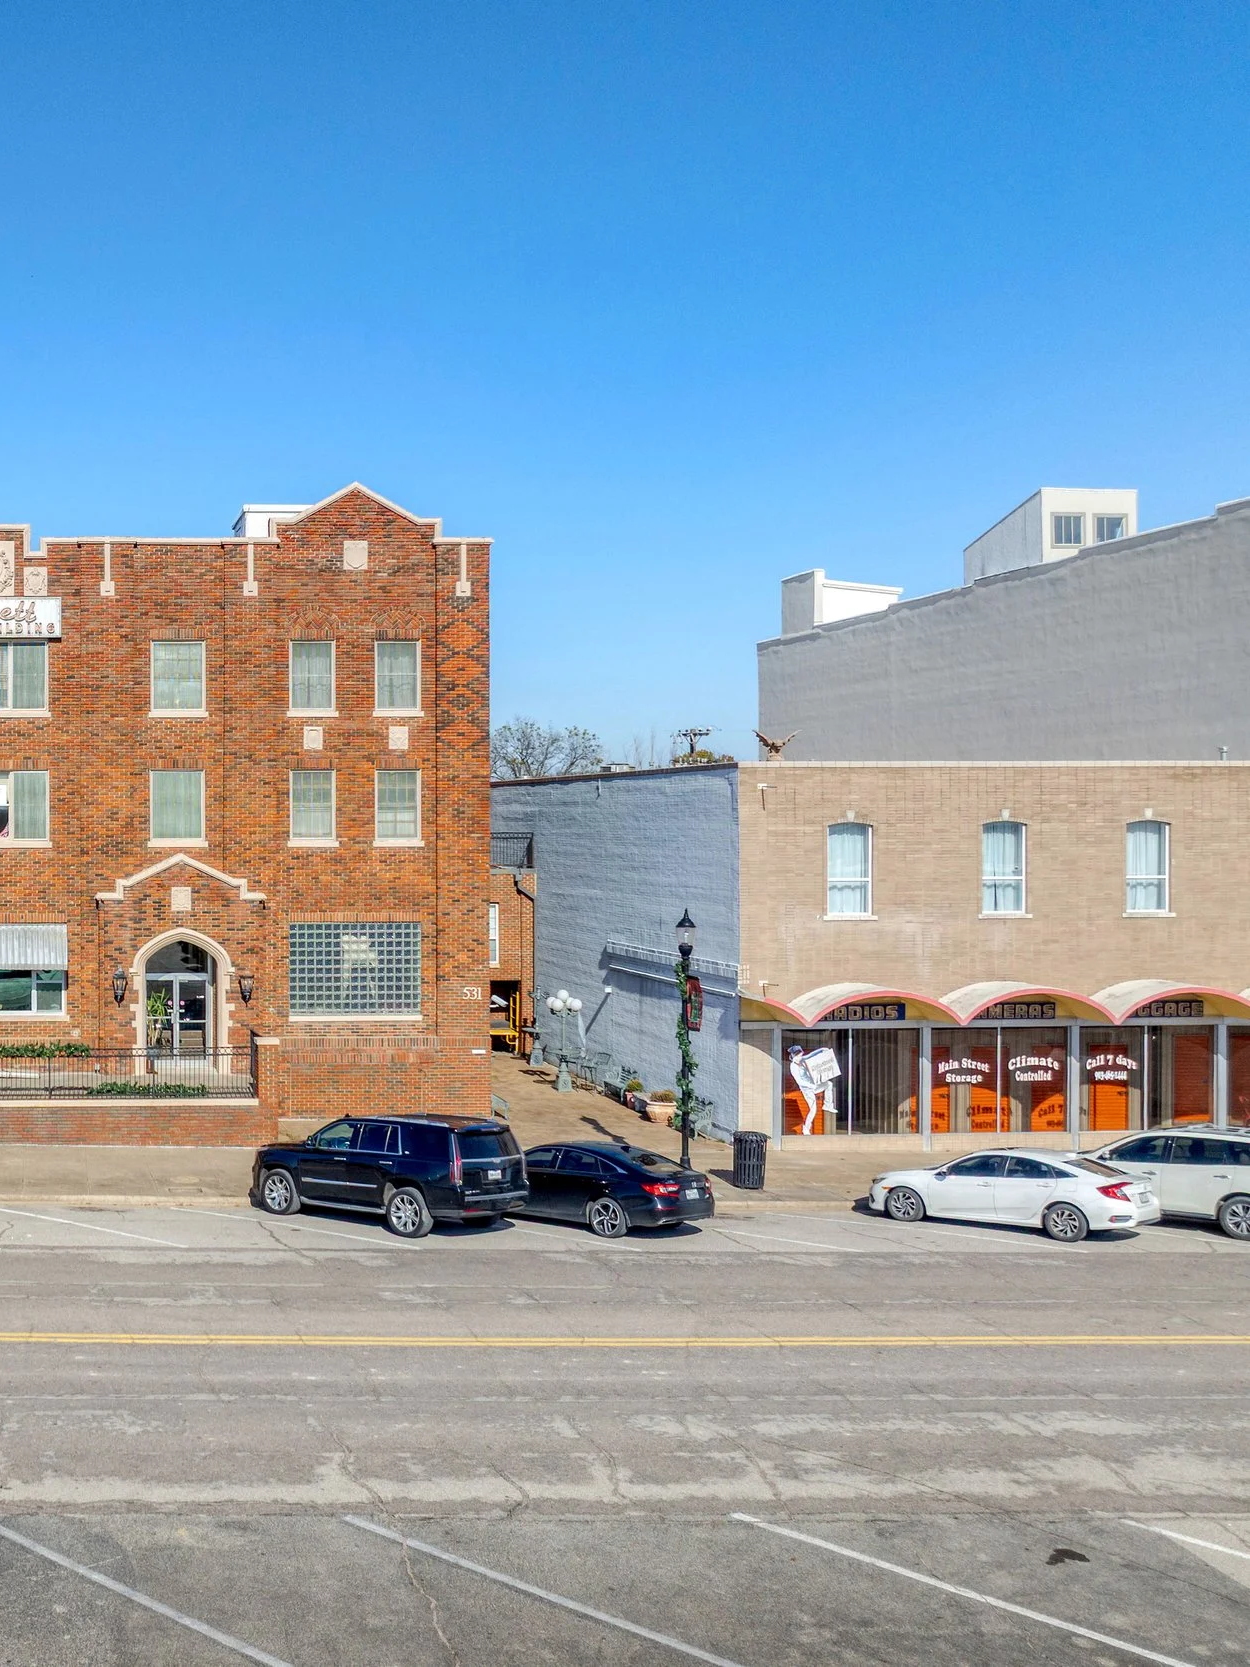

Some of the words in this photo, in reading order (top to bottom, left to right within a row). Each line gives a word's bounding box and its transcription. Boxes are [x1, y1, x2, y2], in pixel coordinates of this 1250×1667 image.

[463, 986, 482, 1000] 531
[938, 1059, 959, 1073] Main
[961, 1058, 990, 1072] Street
[1008, 1055, 1060, 1070] Climate
[1086, 1055, 1105, 1069] Call
[1106, 1055, 1114, 1065] 7
[1115, 1055, 1138, 1069] days
[945, 1073, 983, 1083] Storage
[1015, 1070, 1052, 1081] Controlled
